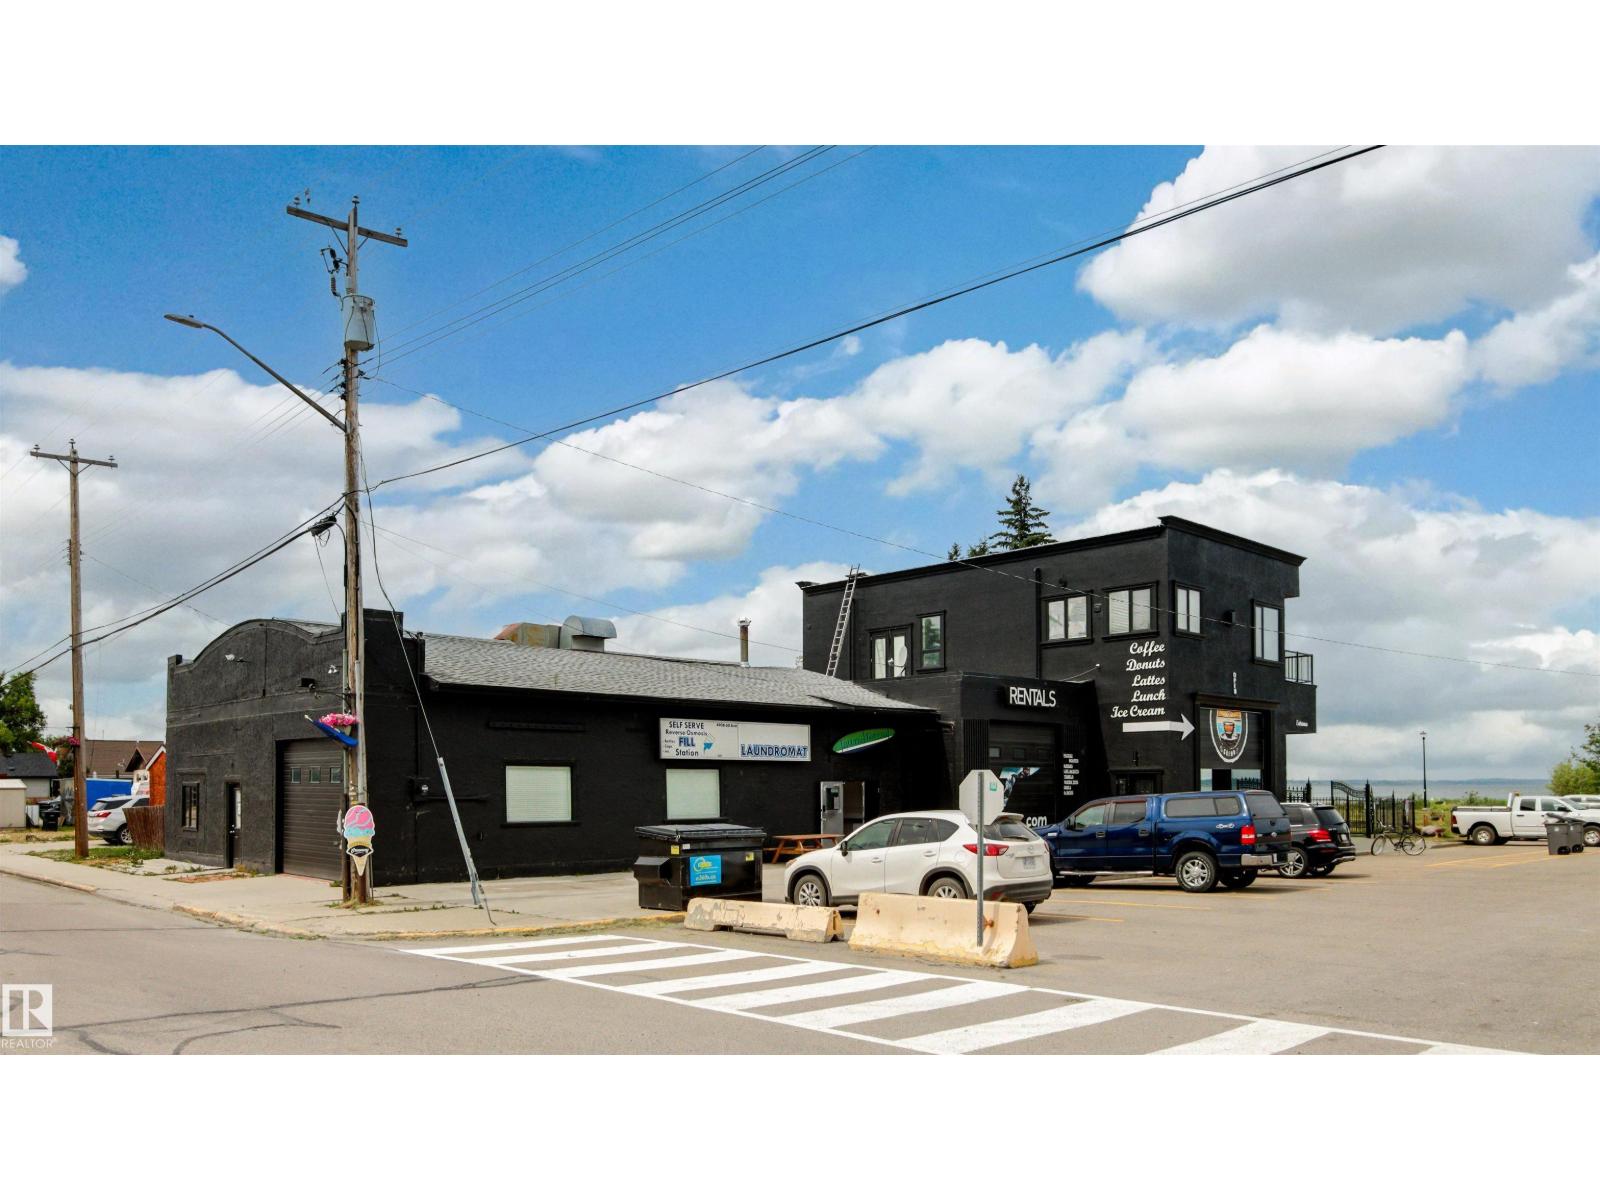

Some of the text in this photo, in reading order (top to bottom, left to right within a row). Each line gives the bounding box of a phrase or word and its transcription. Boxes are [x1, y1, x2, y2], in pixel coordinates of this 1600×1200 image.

[1129, 640, 1166, 657] Coffee
[1125, 658, 1166, 672] Donuts
[1131, 674, 1166, 687] Lattes
[1009, 686, 1057, 707] RENTALS
[1131, 688, 1167, 702] Lunch
[1110, 704, 1166, 718] Ice Cream
[668, 720, 704, 729] SELF SERVE
[678, 736, 696, 747] FILL
[675, 748, 699, 757] Station
[741, 744, 808, 758] LAUNDROMAT
